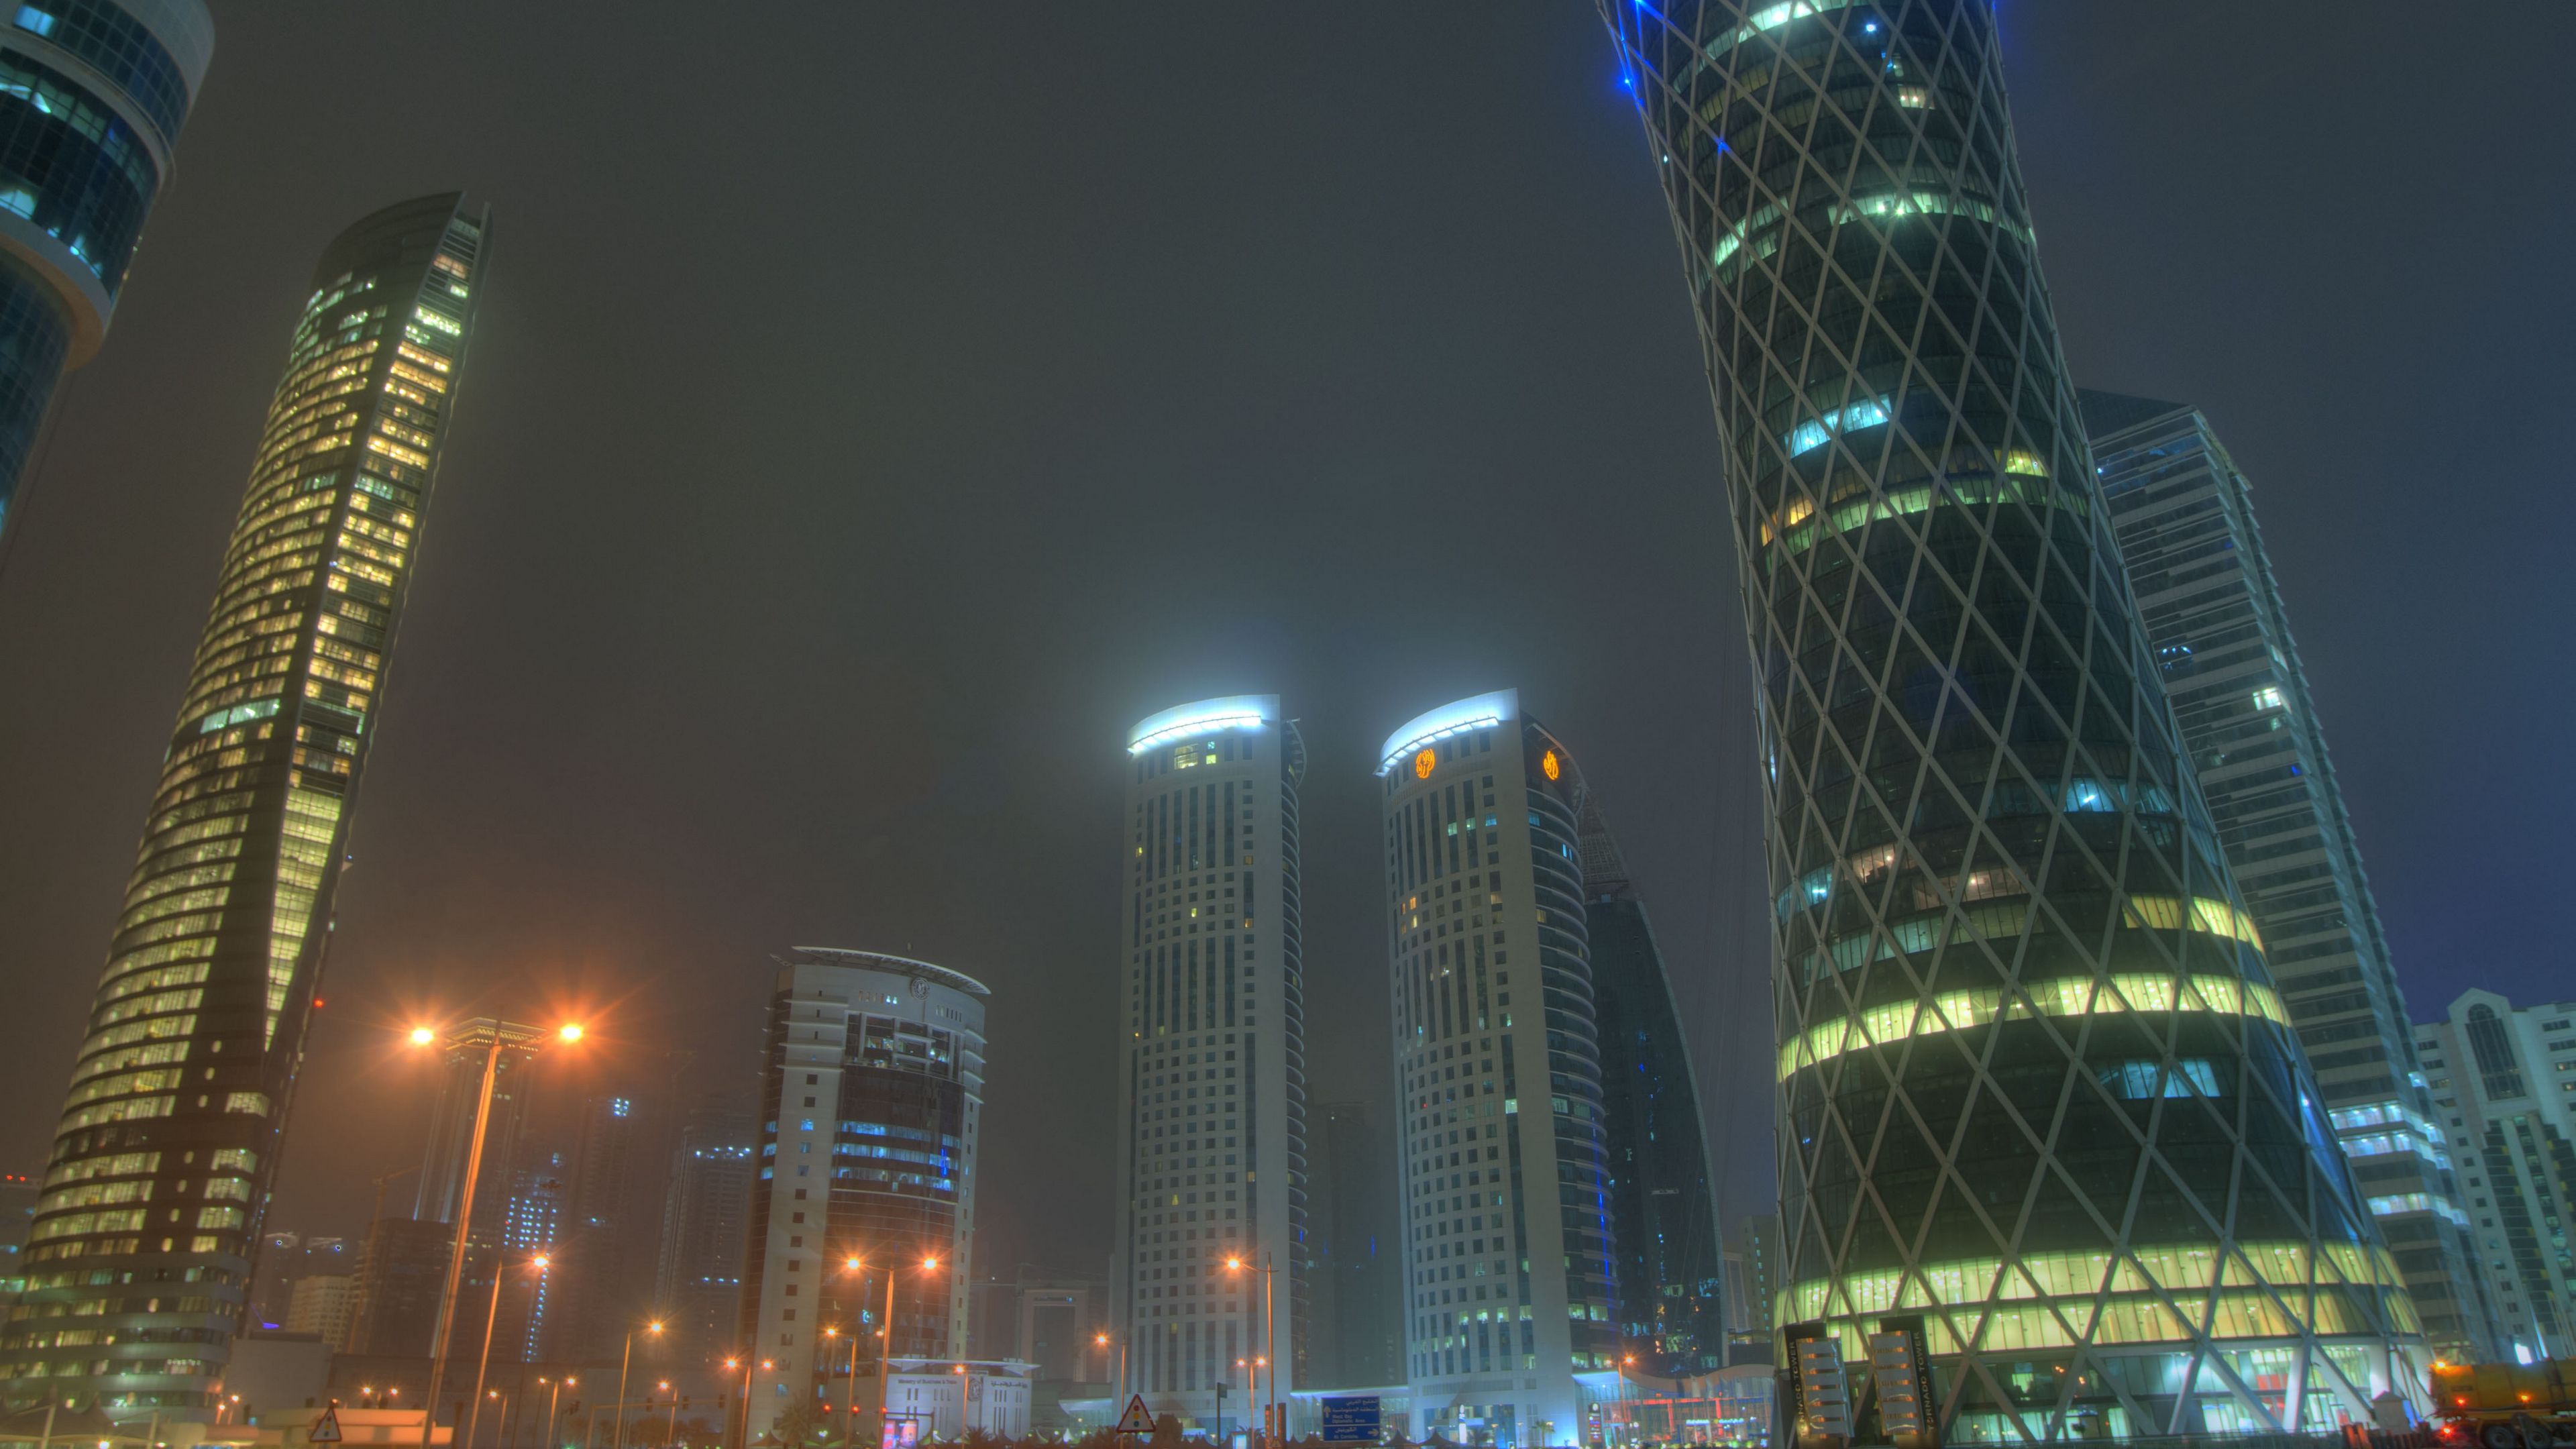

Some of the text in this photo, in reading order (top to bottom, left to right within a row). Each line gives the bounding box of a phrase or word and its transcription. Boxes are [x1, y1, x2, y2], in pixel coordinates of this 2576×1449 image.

[1789, 1342, 1799, 1381] TOWER
[1913, 1332, 1934, 1430] TORNADO TOWER
